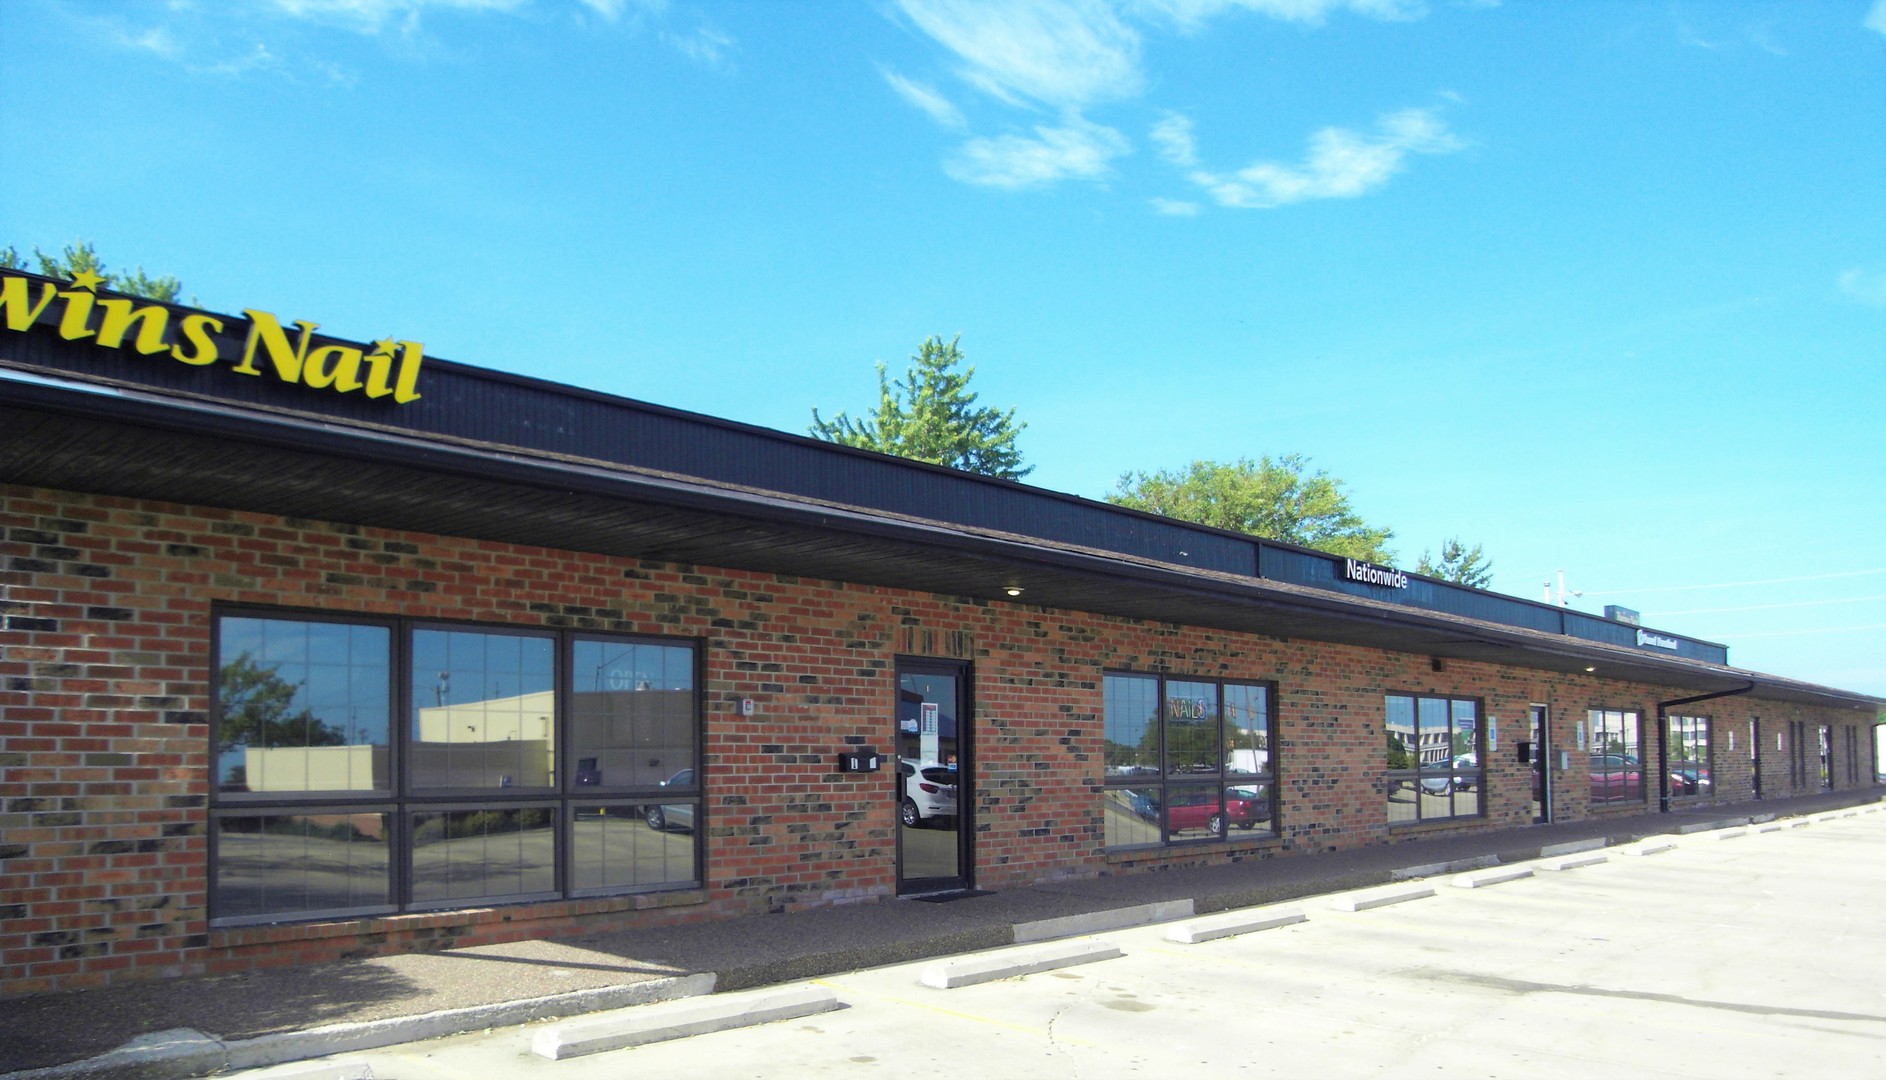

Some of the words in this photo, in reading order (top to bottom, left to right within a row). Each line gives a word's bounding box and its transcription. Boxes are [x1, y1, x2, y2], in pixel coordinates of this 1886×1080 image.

[232, 308, 425, 404] Nail
[1346, 558, 1408, 589] Nationwide
[1170, 698, 1206, 719] NAILS
